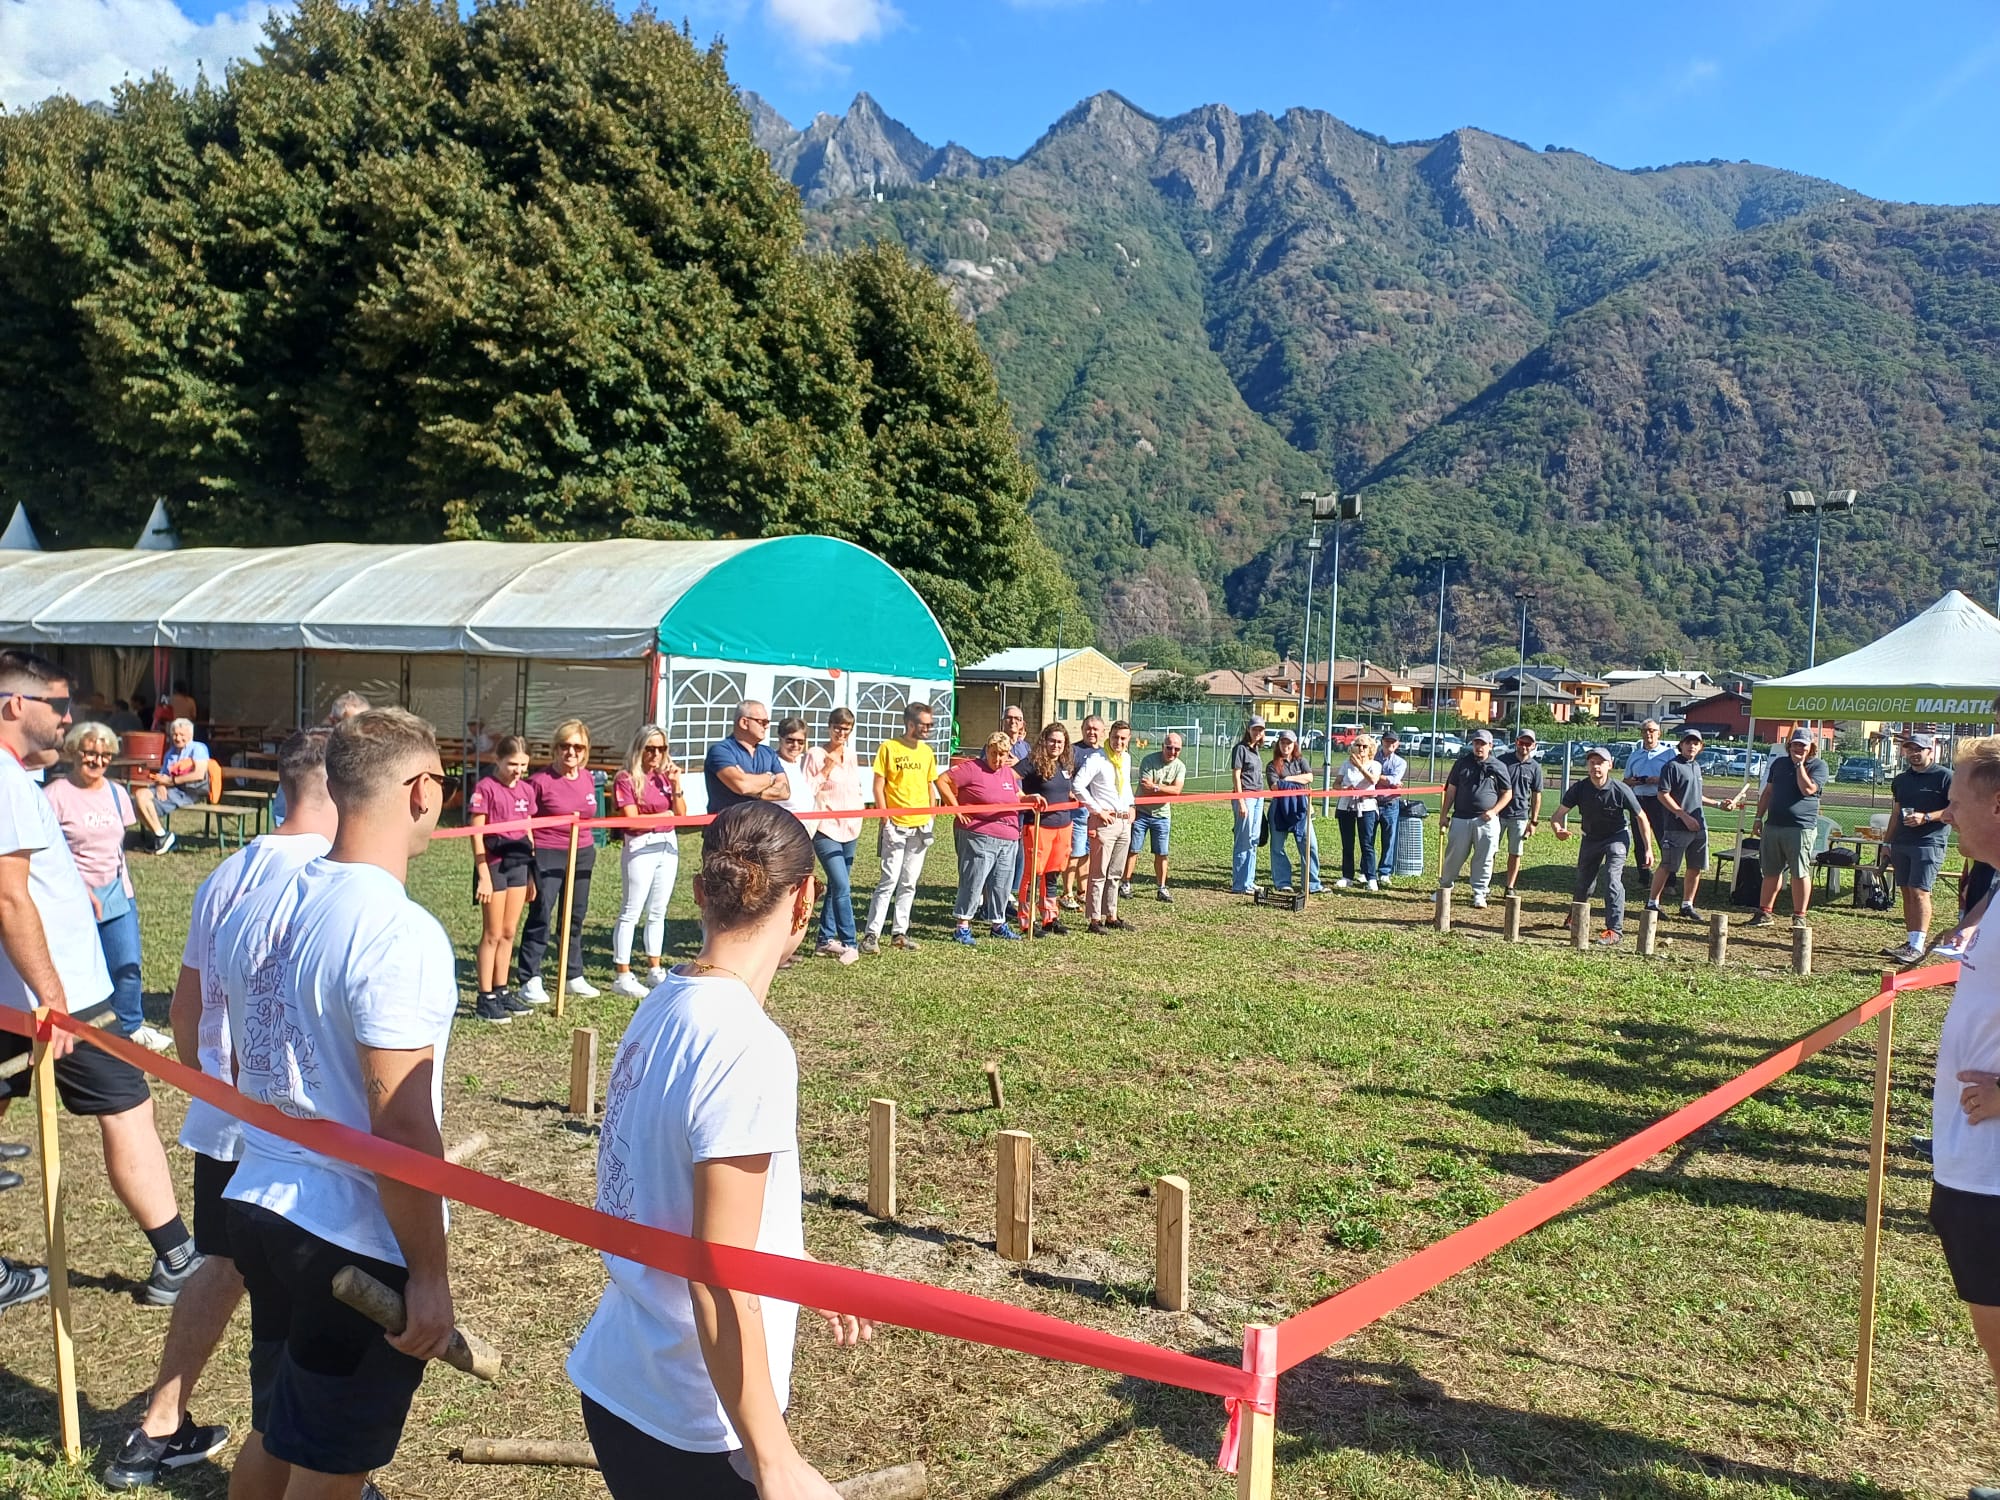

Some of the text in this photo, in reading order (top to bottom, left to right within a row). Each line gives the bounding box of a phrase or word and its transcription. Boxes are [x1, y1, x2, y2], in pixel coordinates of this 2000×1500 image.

[1787, 696, 1996, 714] LAGO MAGGIORE MARATH
